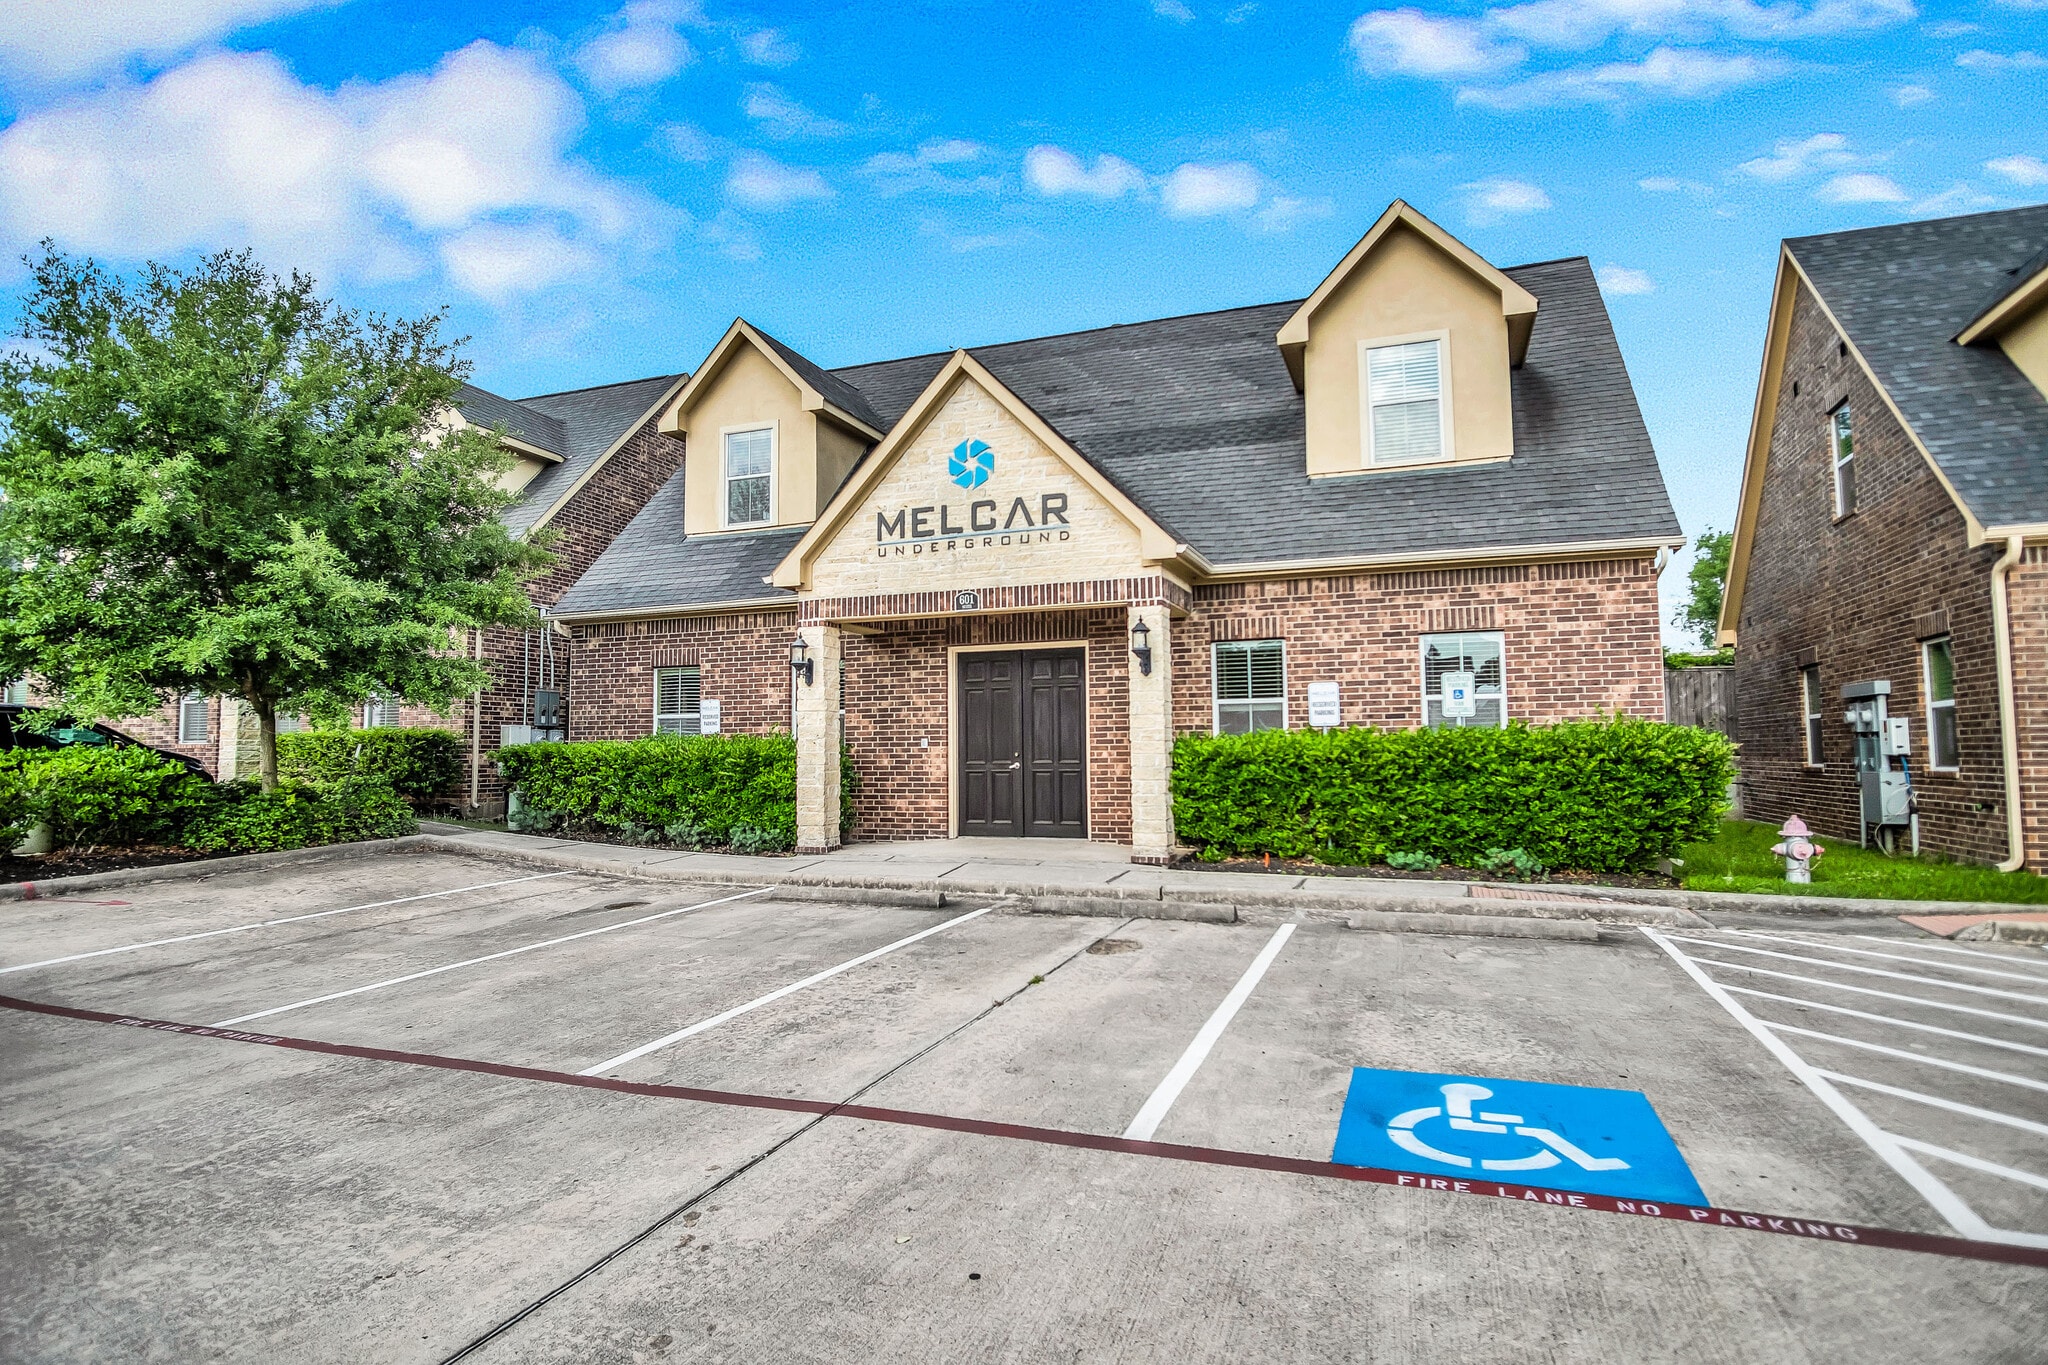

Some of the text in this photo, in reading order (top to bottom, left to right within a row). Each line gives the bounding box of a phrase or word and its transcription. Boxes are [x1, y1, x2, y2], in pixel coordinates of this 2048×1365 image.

[877, 493, 1070, 542] MELCAR
[878, 531, 1070, 557] UNDERGROUND
[959, 594, 974, 605] 601
[1397, 1174, 1859, 1241] FIRE LANE NO PARKING
